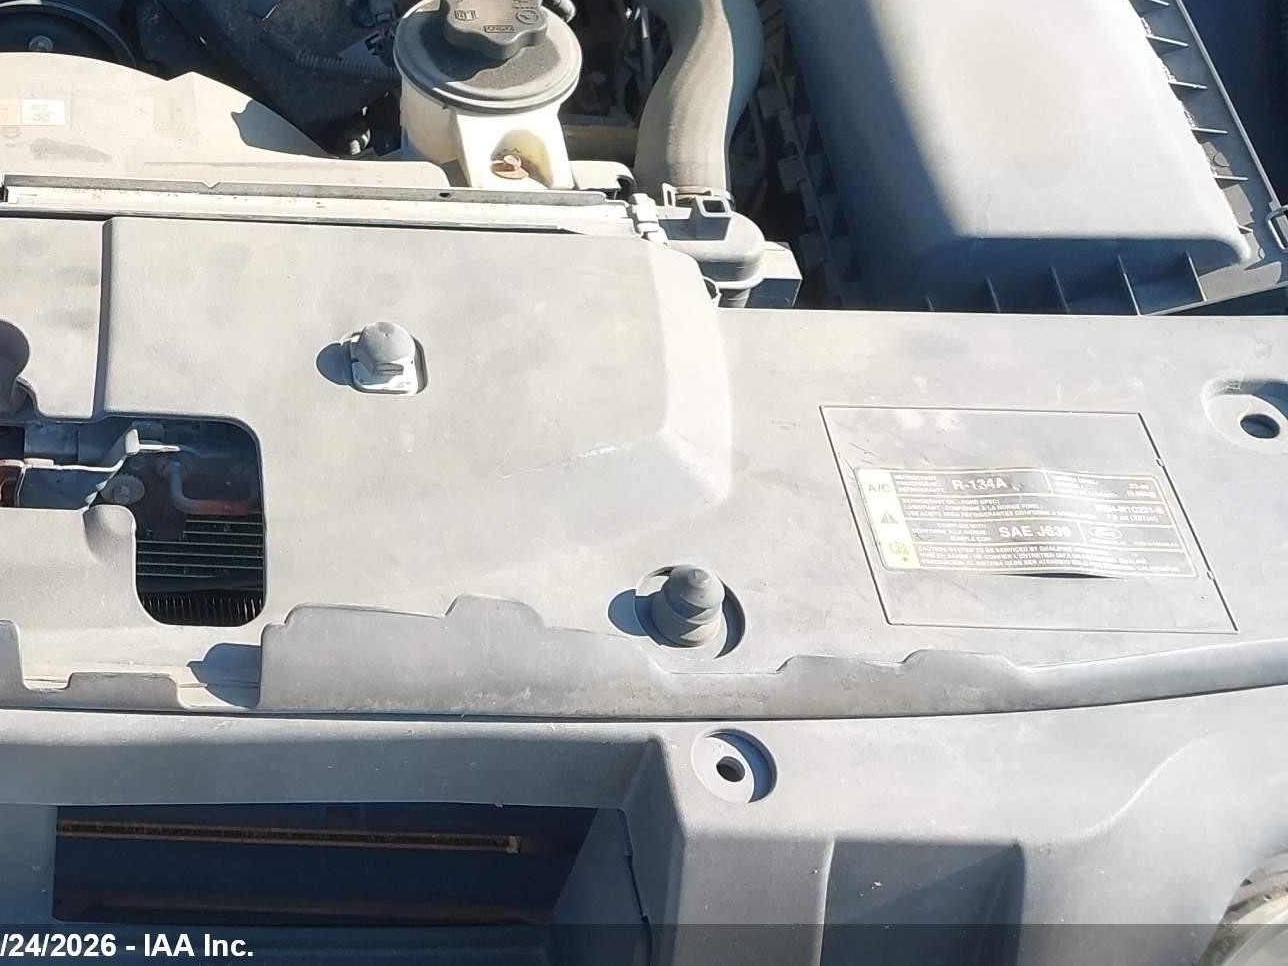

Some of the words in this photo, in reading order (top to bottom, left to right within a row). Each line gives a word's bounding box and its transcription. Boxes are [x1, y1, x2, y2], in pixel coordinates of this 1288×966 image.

[867, 483, 892, 493] A/C
[951, 477, 1009, 491] R-134A
[998, 526, 1034, 539] SAE
